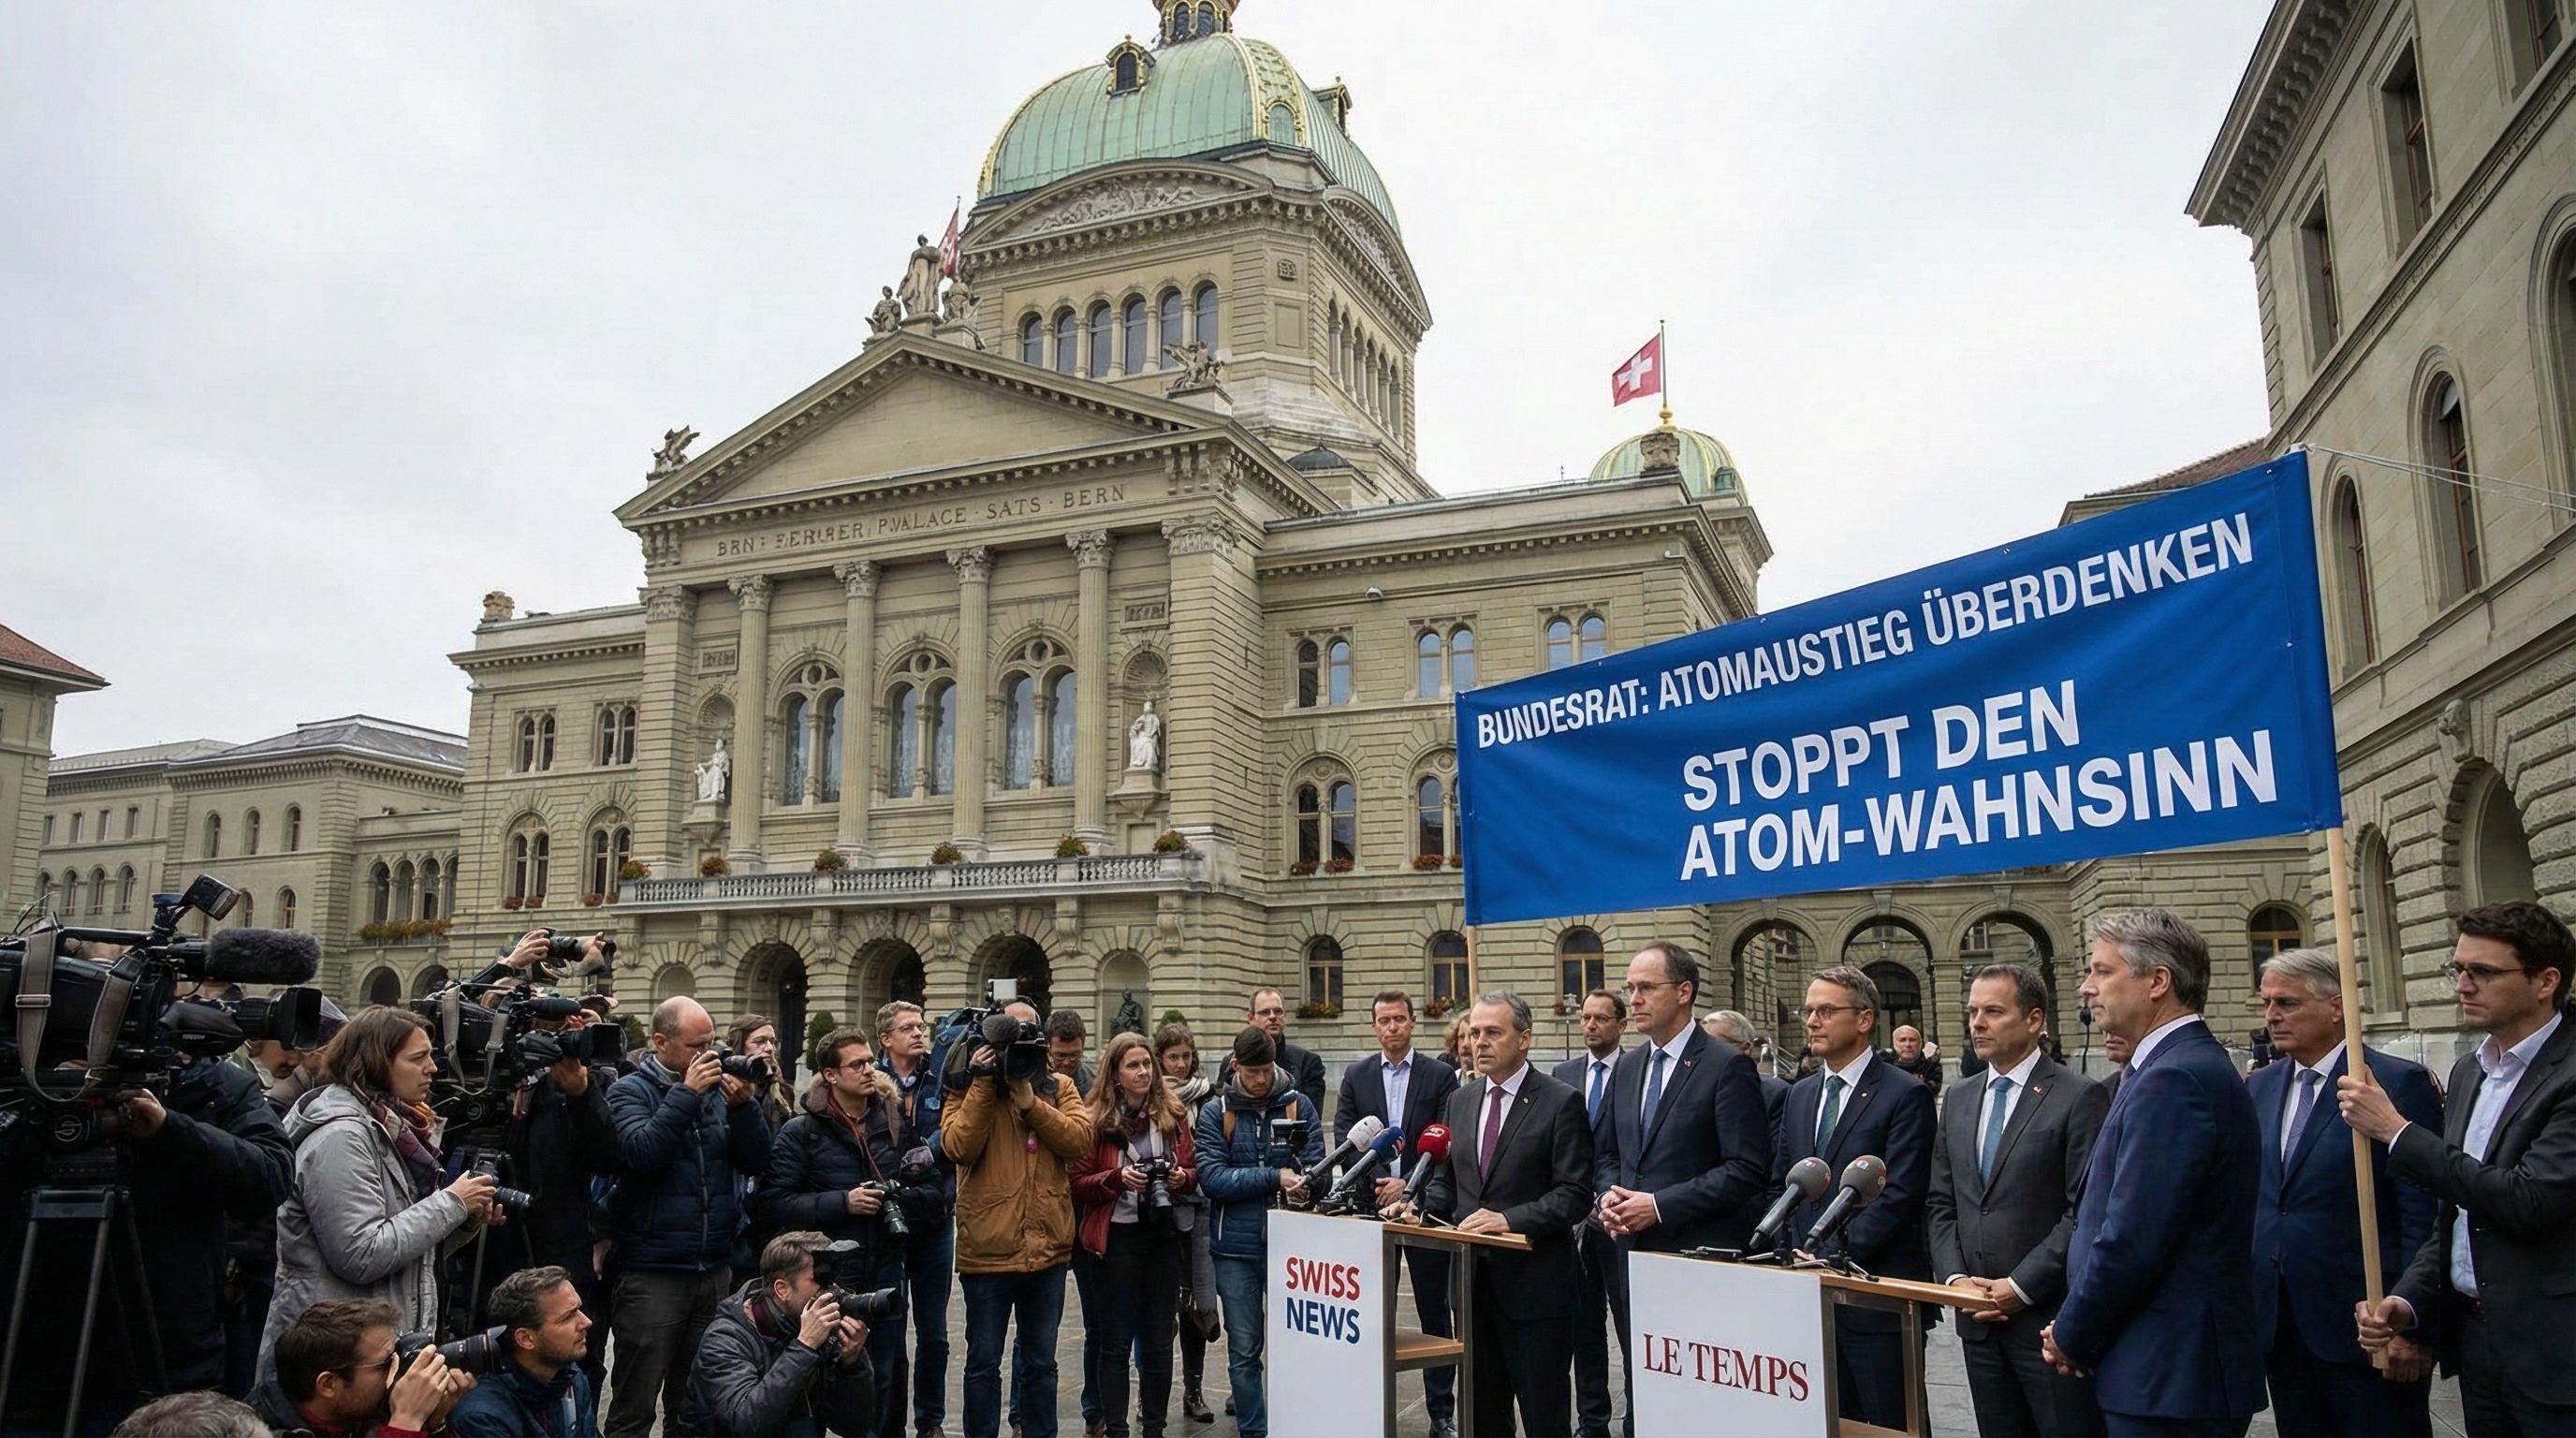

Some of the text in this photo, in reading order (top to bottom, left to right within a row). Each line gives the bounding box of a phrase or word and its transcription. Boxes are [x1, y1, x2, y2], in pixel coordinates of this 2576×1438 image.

[986, 497, 1042, 520] SATS
[1062, 483, 1124, 509] BERN
[1477, 512, 2253, 749] BUNDESRAT: ATOMAUSTIEG ÜBERDENKEN
[1683, 679, 2080, 812] STOPPT DEN
[1680, 729, 2277, 881] ATOM-WAHNSINN
[1285, 1256, 1361, 1301] SWISS
[1286, 1297, 1361, 1344] NEWS
[1643, 1332, 1809, 1402] LE TEMPS
